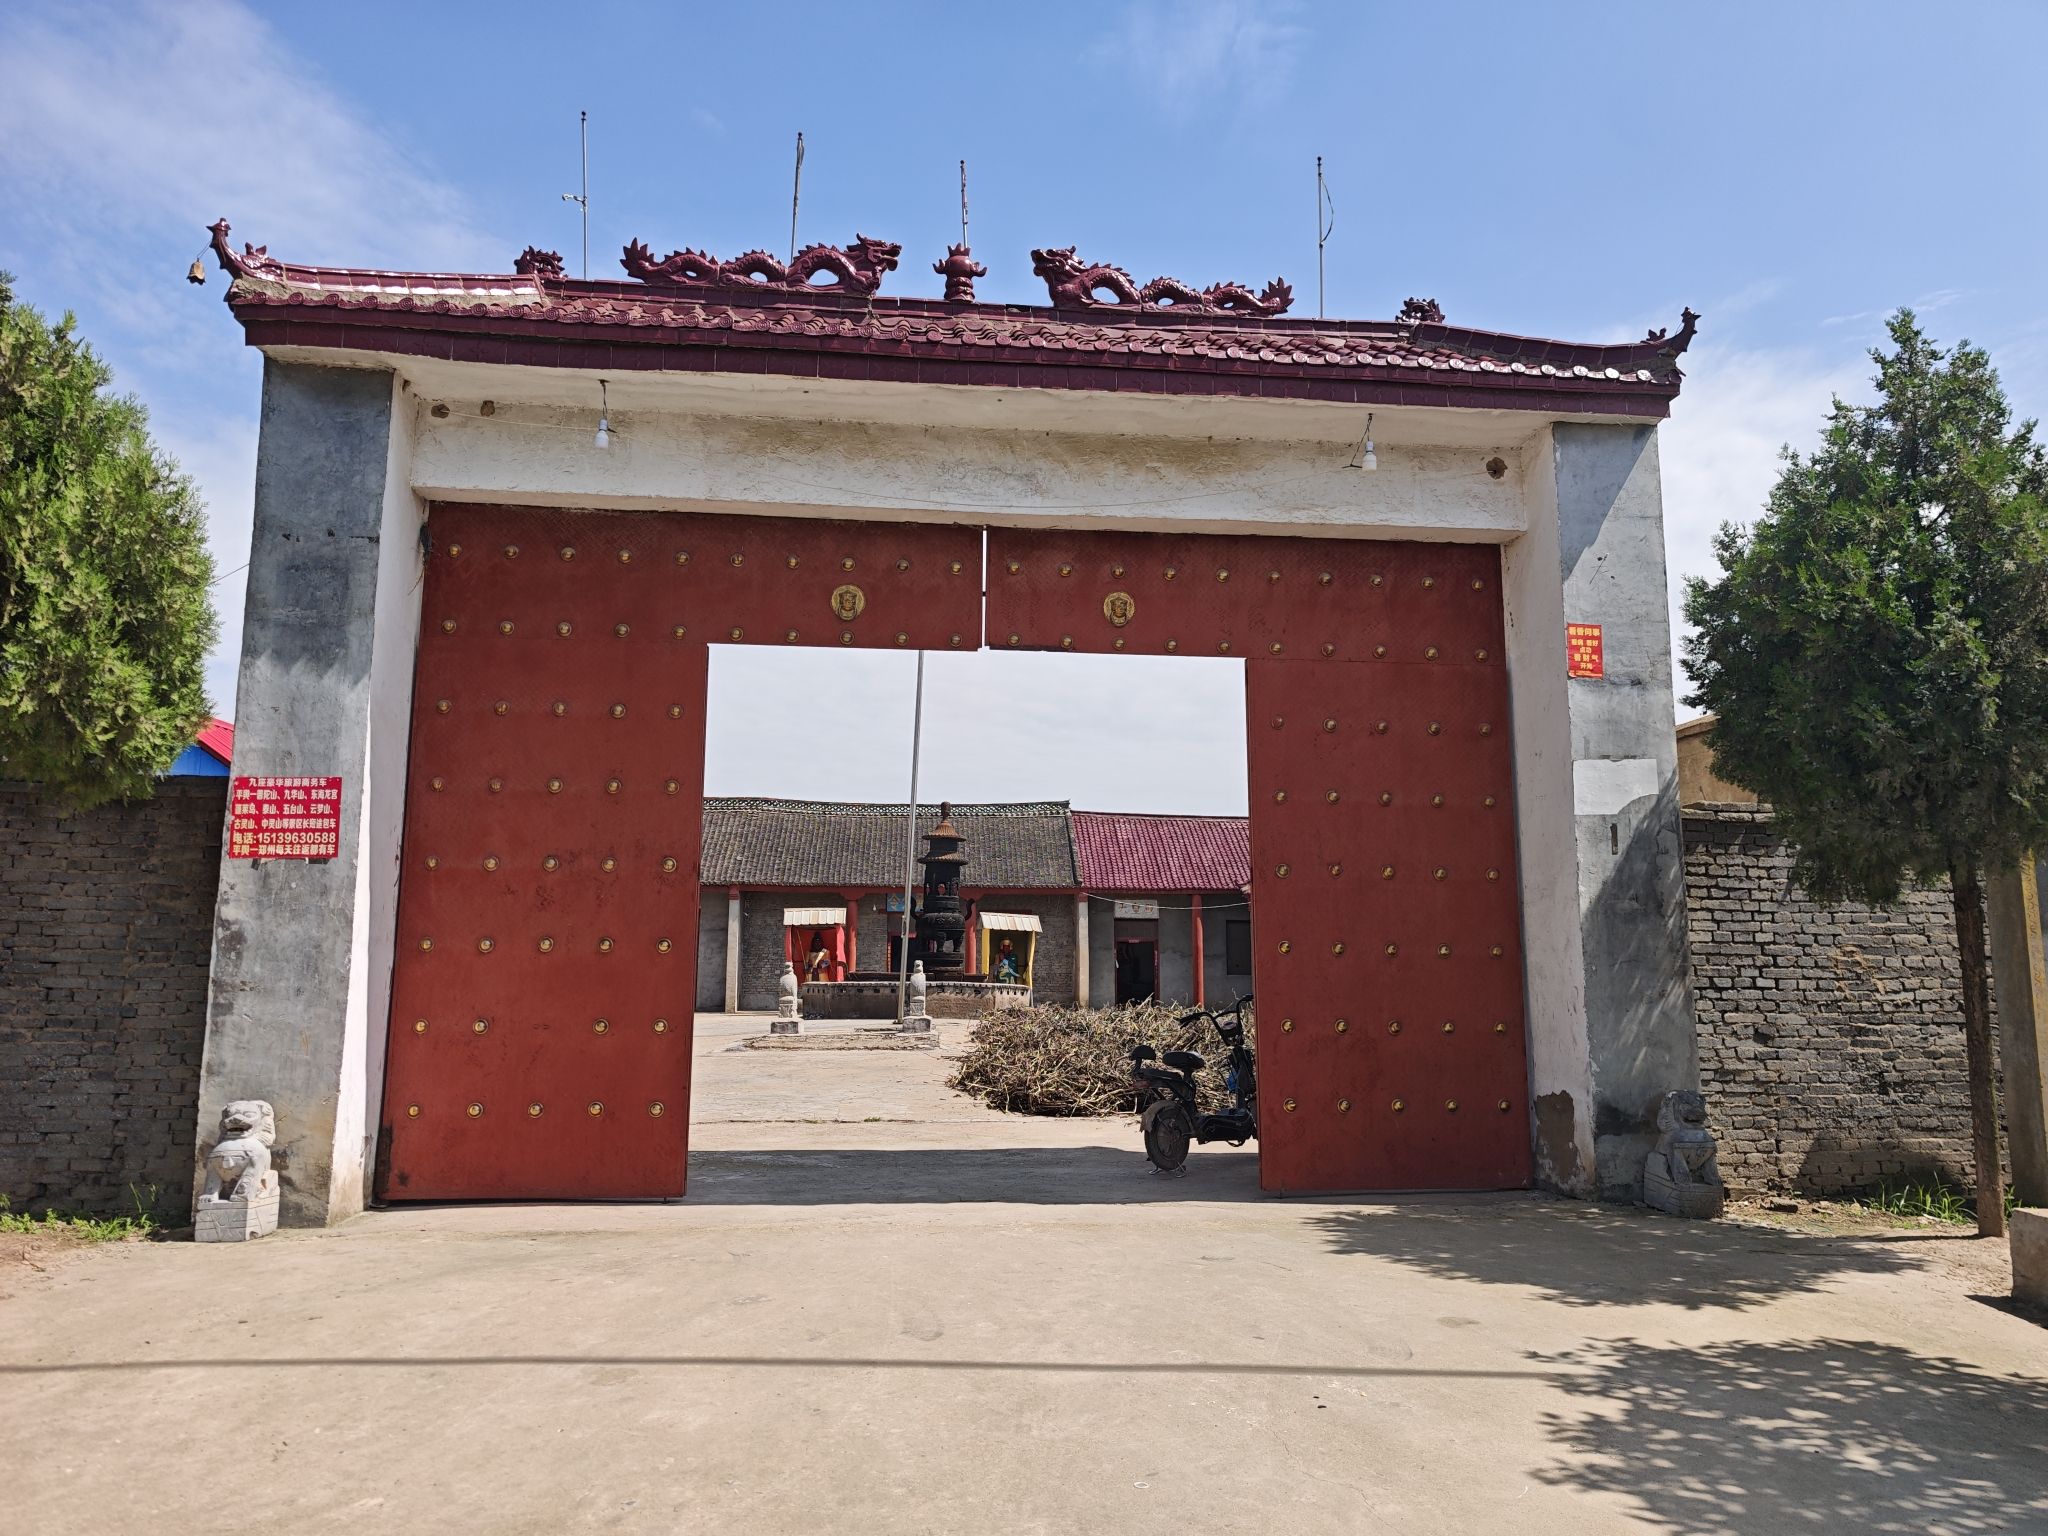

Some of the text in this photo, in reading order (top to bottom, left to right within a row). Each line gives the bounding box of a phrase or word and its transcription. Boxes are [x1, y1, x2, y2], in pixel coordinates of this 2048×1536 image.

[248, 778, 328, 787] 九座豪华旅游商务车
